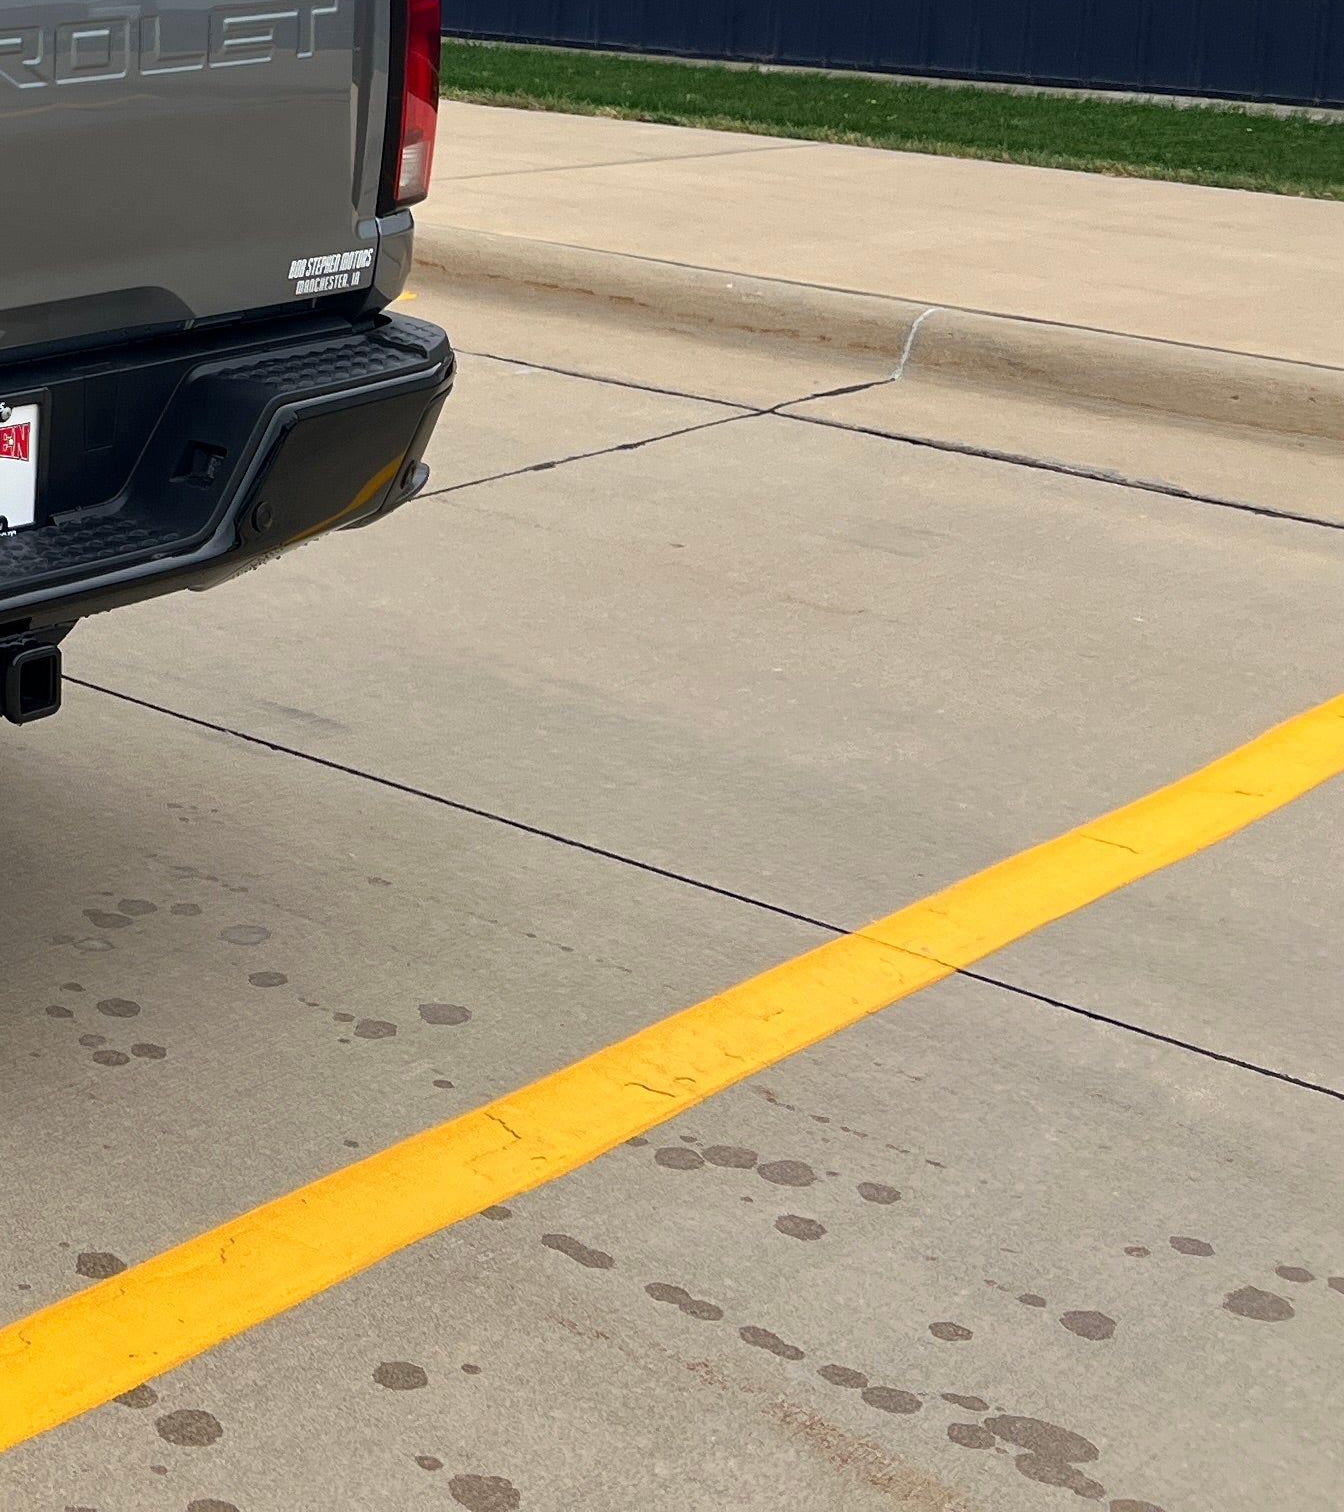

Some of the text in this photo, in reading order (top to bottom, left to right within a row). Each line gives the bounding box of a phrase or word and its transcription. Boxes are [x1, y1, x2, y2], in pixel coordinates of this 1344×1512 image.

[288, 248, 373, 279] BOB STEPHEN MOTORS
